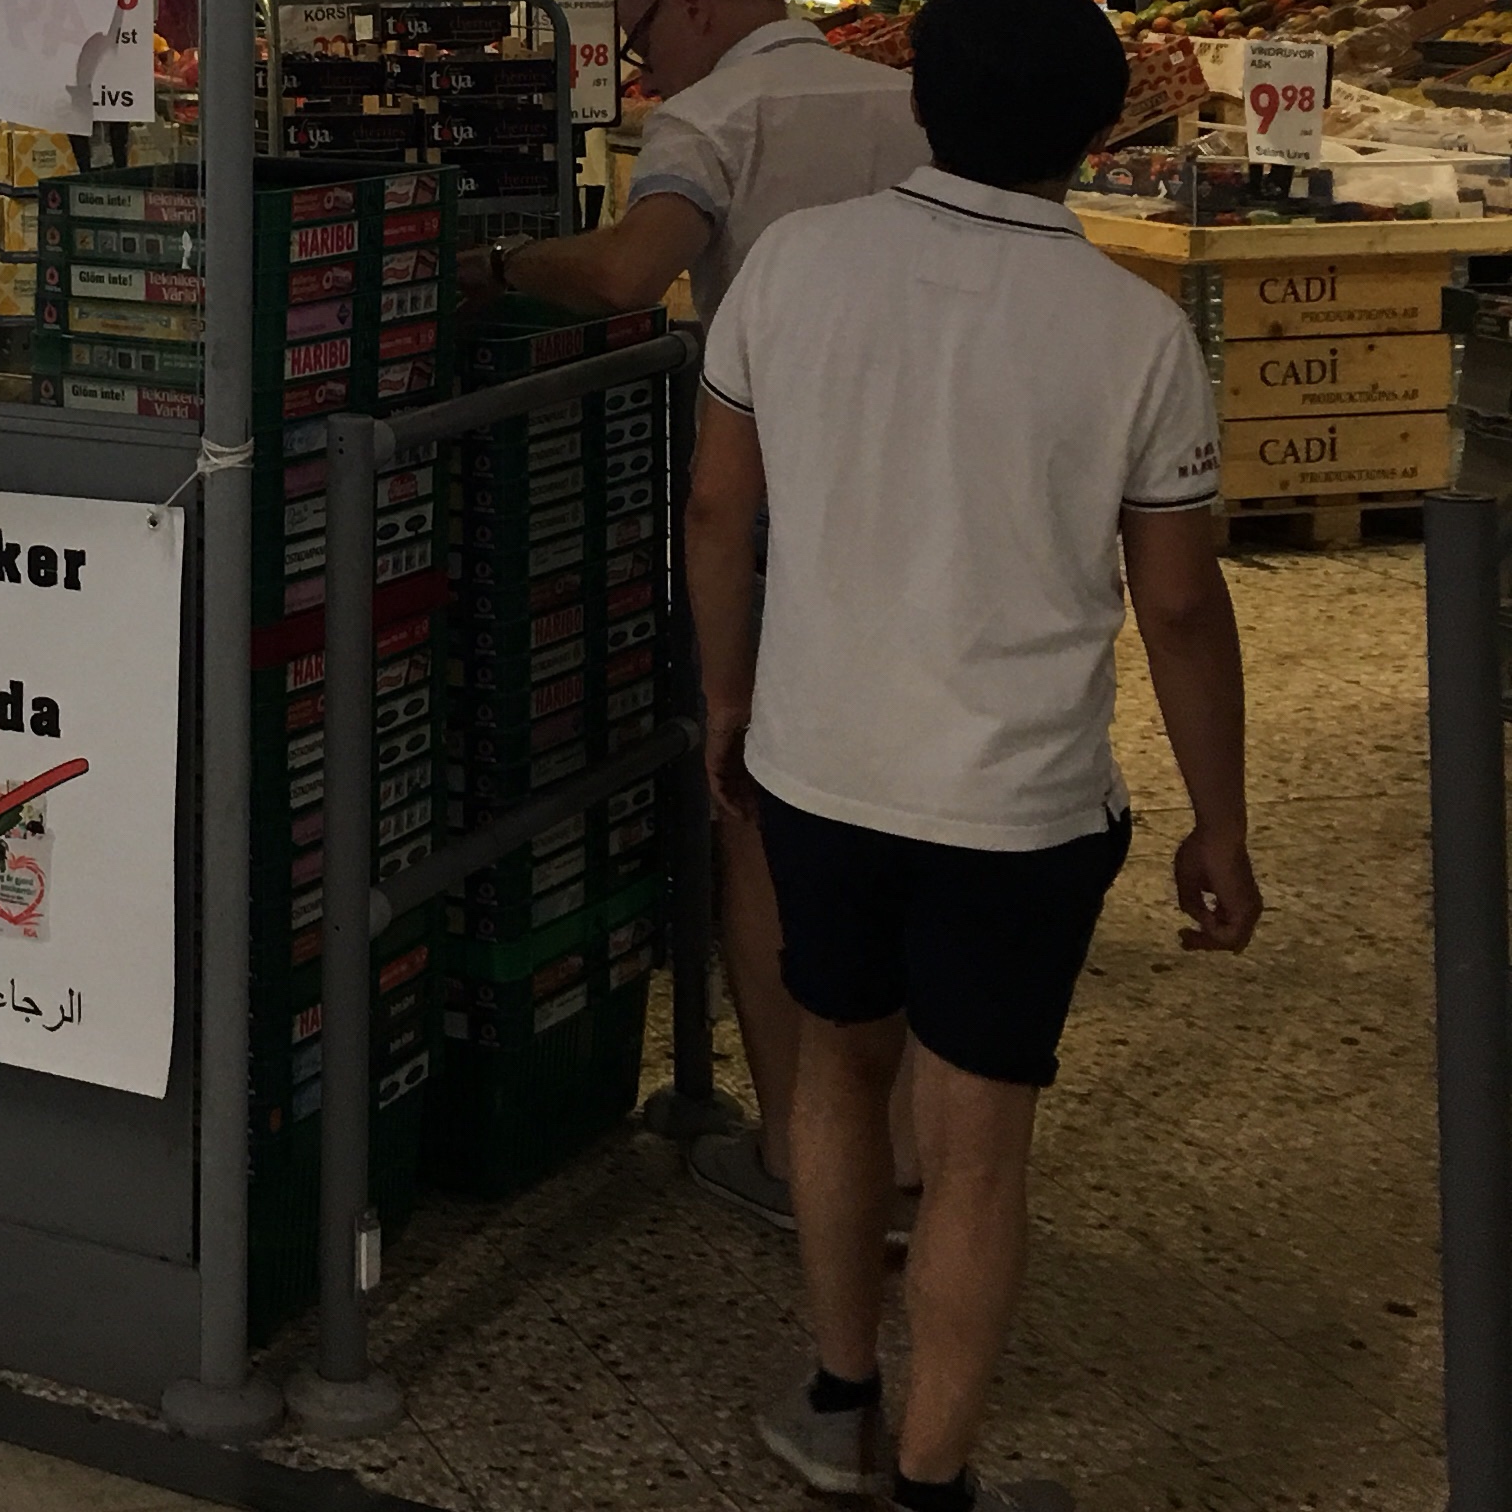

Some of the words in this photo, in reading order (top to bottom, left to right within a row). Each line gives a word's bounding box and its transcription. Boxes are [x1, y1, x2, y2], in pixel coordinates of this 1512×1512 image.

[78, 192, 104, 206] Glöm
[107, 194, 132, 208] inte!
[298, 223, 355, 258] HARIBO
[78, 270, 105, 285] Glöm
[108, 272, 133, 287] inte!
[290, 339, 349, 377] HARIBO
[534, 328, 583, 364] HARIBO
[71, 384, 98, 398] Glöm
[100, 386, 126, 402] inte!
[534, 607, 583, 647] HARIBO
[534, 674, 583, 715] HARIBO
